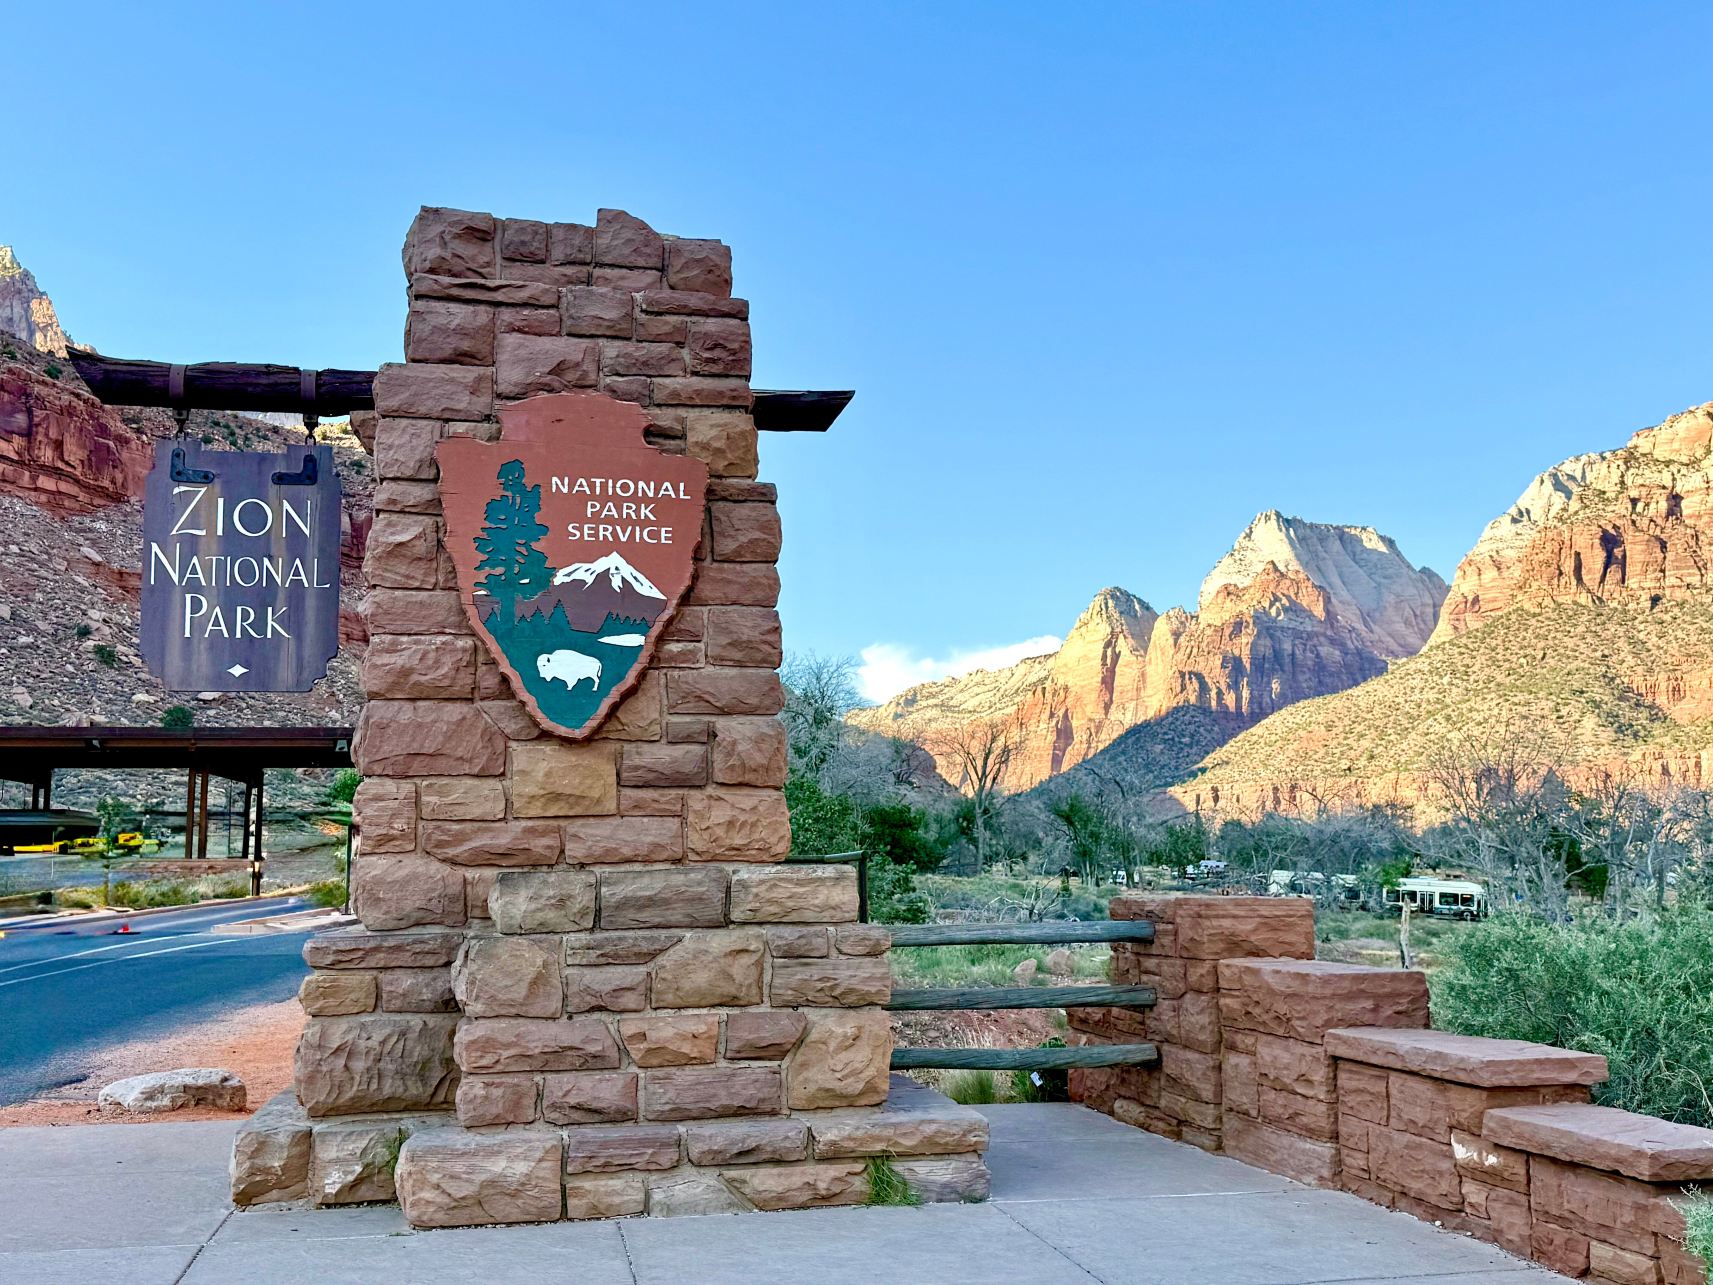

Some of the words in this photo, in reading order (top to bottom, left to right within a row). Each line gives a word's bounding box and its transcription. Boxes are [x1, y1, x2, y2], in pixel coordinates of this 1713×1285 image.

[551, 476, 691, 499] NATIONAL
[170, 486, 311, 538] ZION
[586, 501, 657, 521] PARK
[567, 523, 673, 544] SERVICE
[150, 541, 331, 588] NATIONAL
[183, 593, 292, 639] PARK
